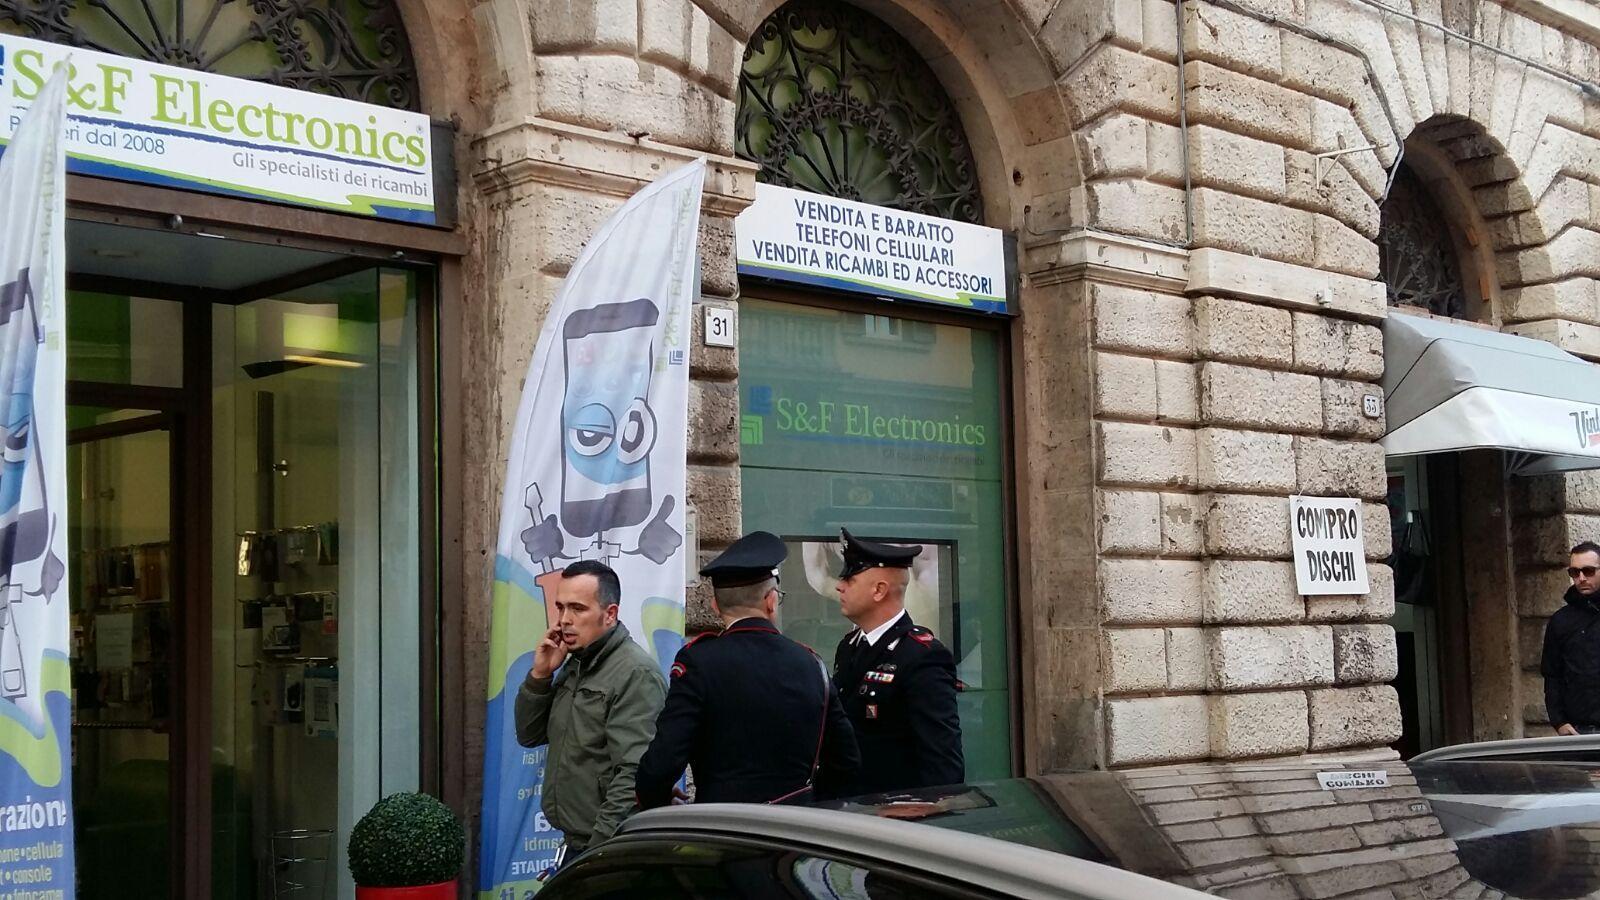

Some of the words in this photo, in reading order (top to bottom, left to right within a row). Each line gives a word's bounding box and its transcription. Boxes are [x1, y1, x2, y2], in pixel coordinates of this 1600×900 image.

[12, 49, 133, 114] S&F
[151, 73, 426, 167] Electronics
[86, 128, 117, 147] dal
[122, 133, 165, 155] 2008
[233, 152, 254, 168] Gli
[259, 159, 339, 182] specialisti
[344, 170, 367, 187] dei
[371, 175, 428, 197] ricambi
[794, 198, 866, 229] VENDITA
[872, 213, 880, 231] E
[885, 215, 954, 244] BARATTO
[796, 222, 870, 253] TELEFONI
[875, 237, 954, 266] CELLULARI
[752, 239, 821, 269] VENDITA
[826, 251, 888, 278] RICAMBI
[893, 263, 910, 281] ED
[915, 266, 992, 295] ACCESSORI
[712, 316, 727, 337] 31
[776, 398, 835, 433] S&F
[844, 404, 986, 446] Electronics
[1296, 505, 1358, 540] COMPRO
[1306, 549, 1356, 582] DISCHI
